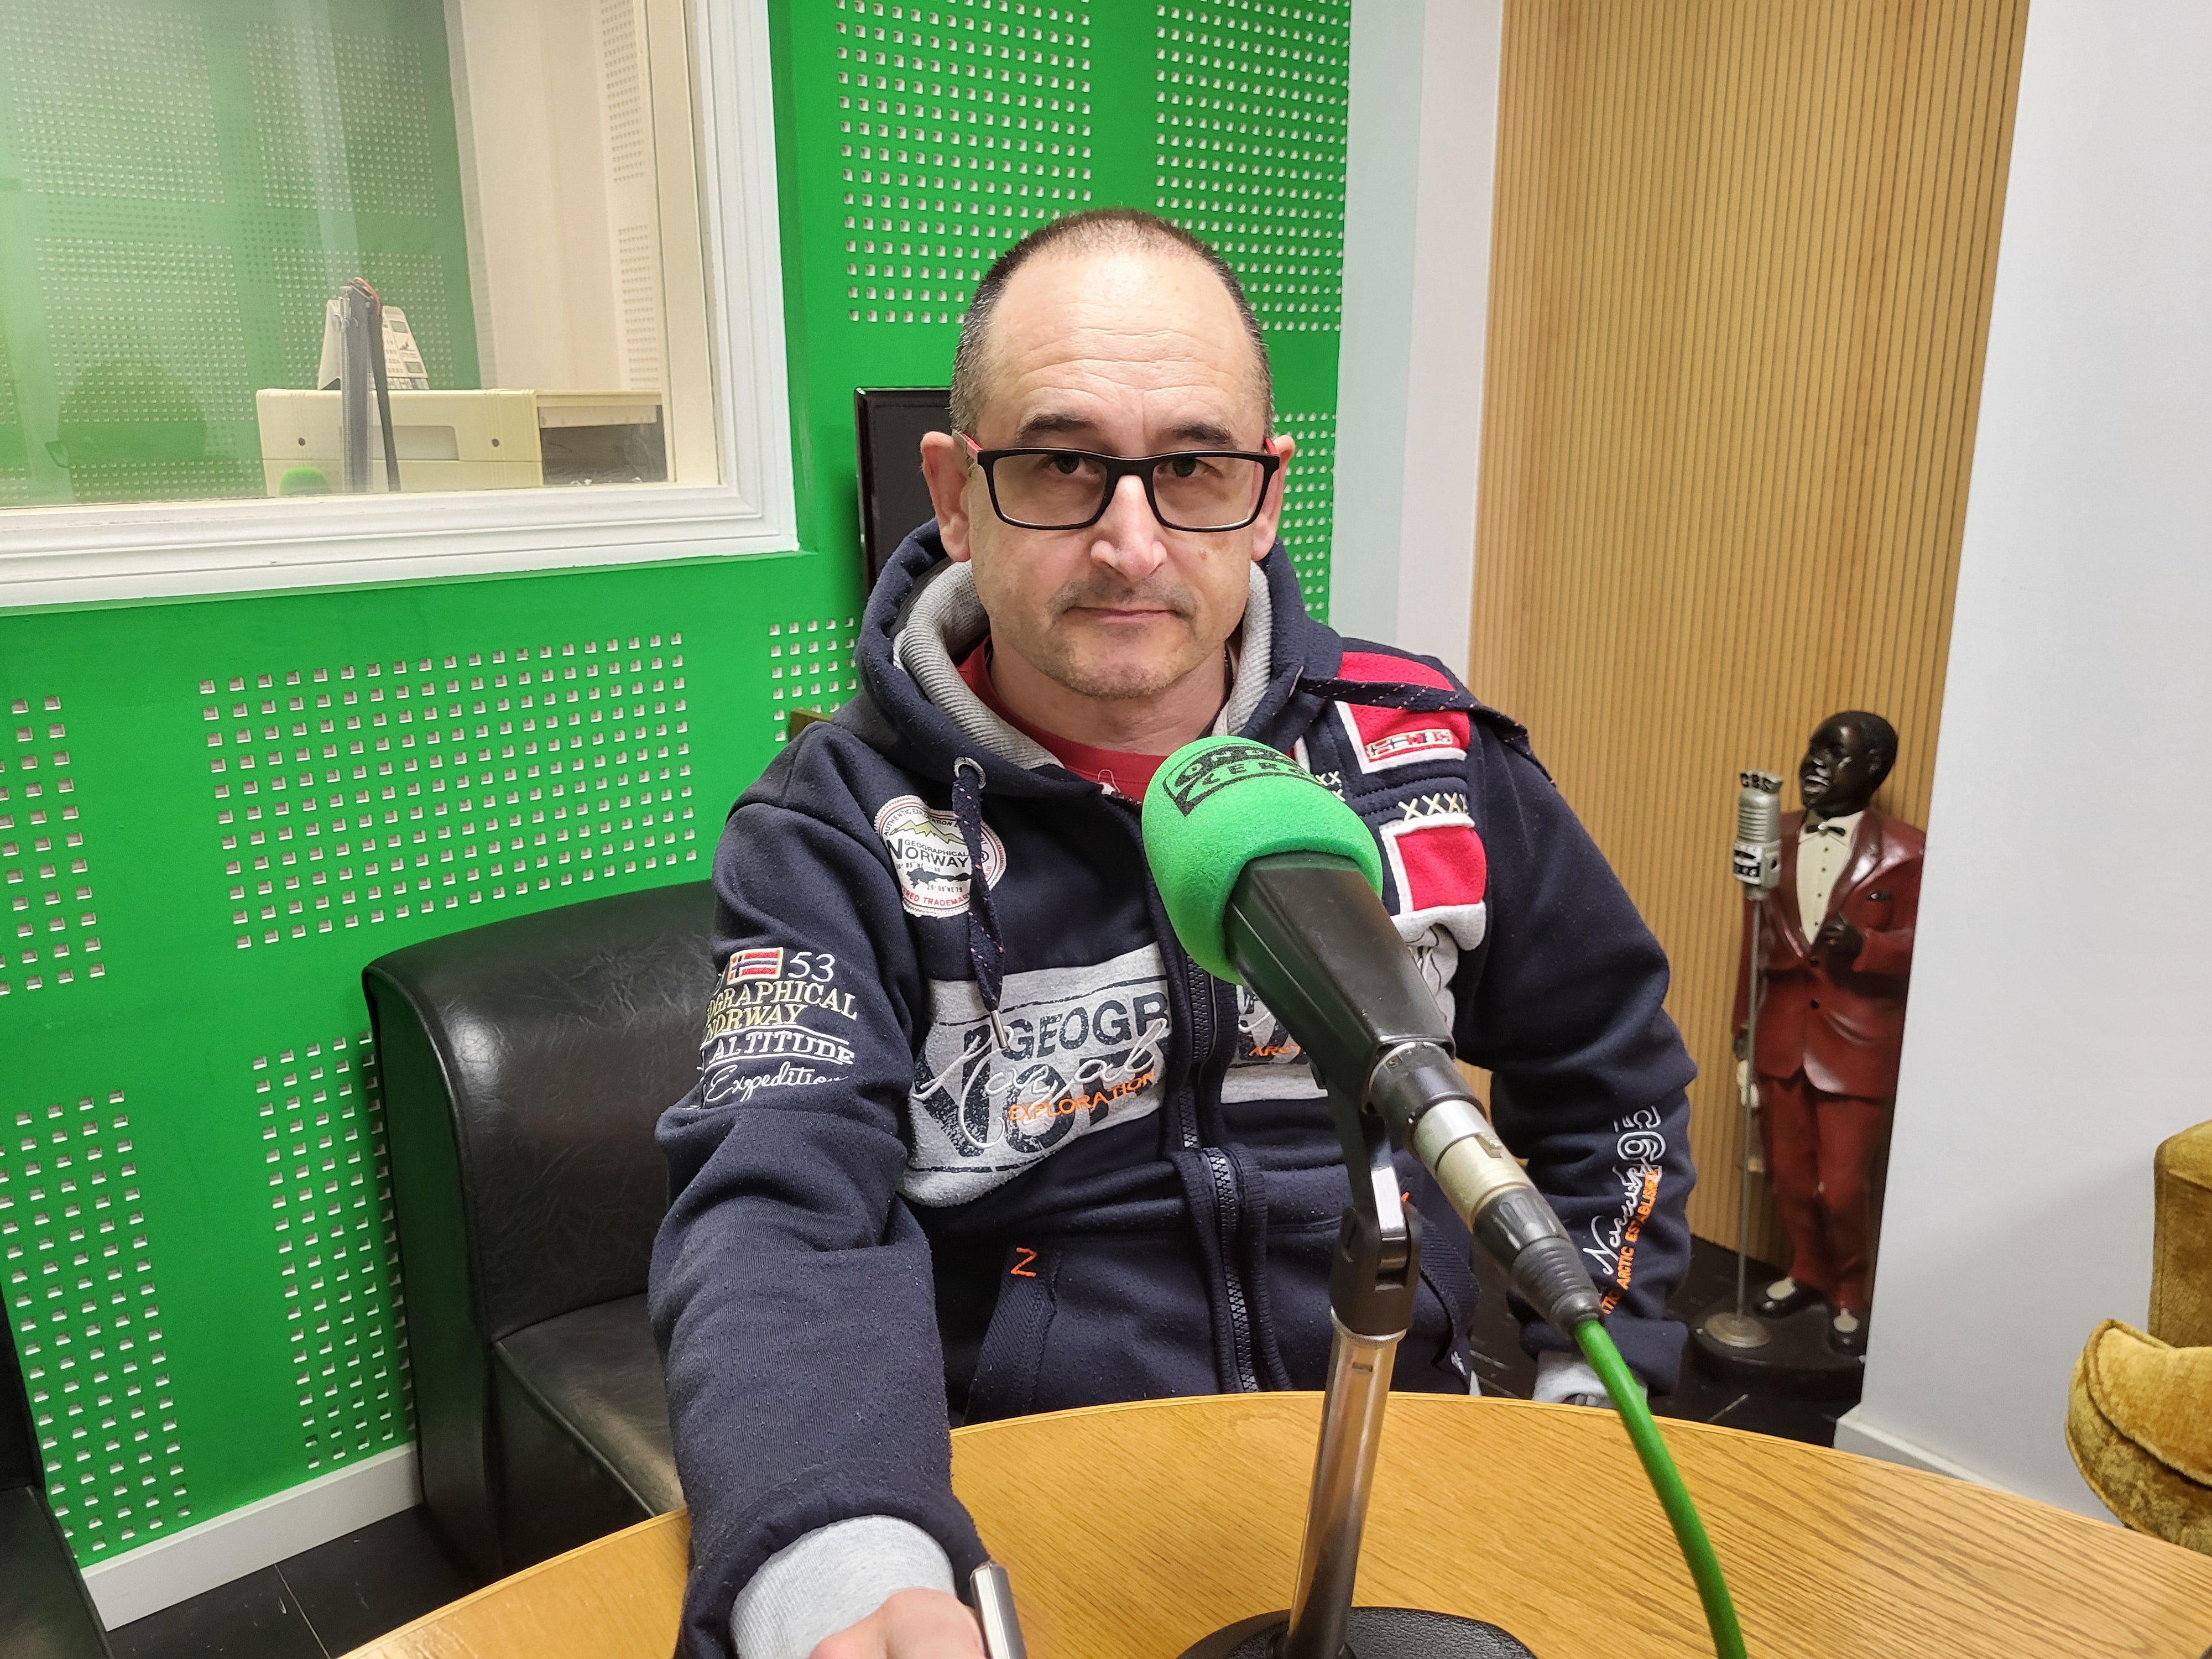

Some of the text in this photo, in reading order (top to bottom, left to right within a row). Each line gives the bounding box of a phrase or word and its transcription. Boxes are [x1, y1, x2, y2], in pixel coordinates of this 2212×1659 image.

[886, 838, 969, 868] NORWAY
[905, 839, 969, 857] GEOGRAPHICAL
[787, 951, 835, 982] 53
[705, 1004, 808, 1041] NORWAY
[711, 1030, 855, 1065] ALTITUDE
[1009, 1067, 1156, 1121] EXPLORATION
[1616, 1245, 1635, 1290] ARCTIC
